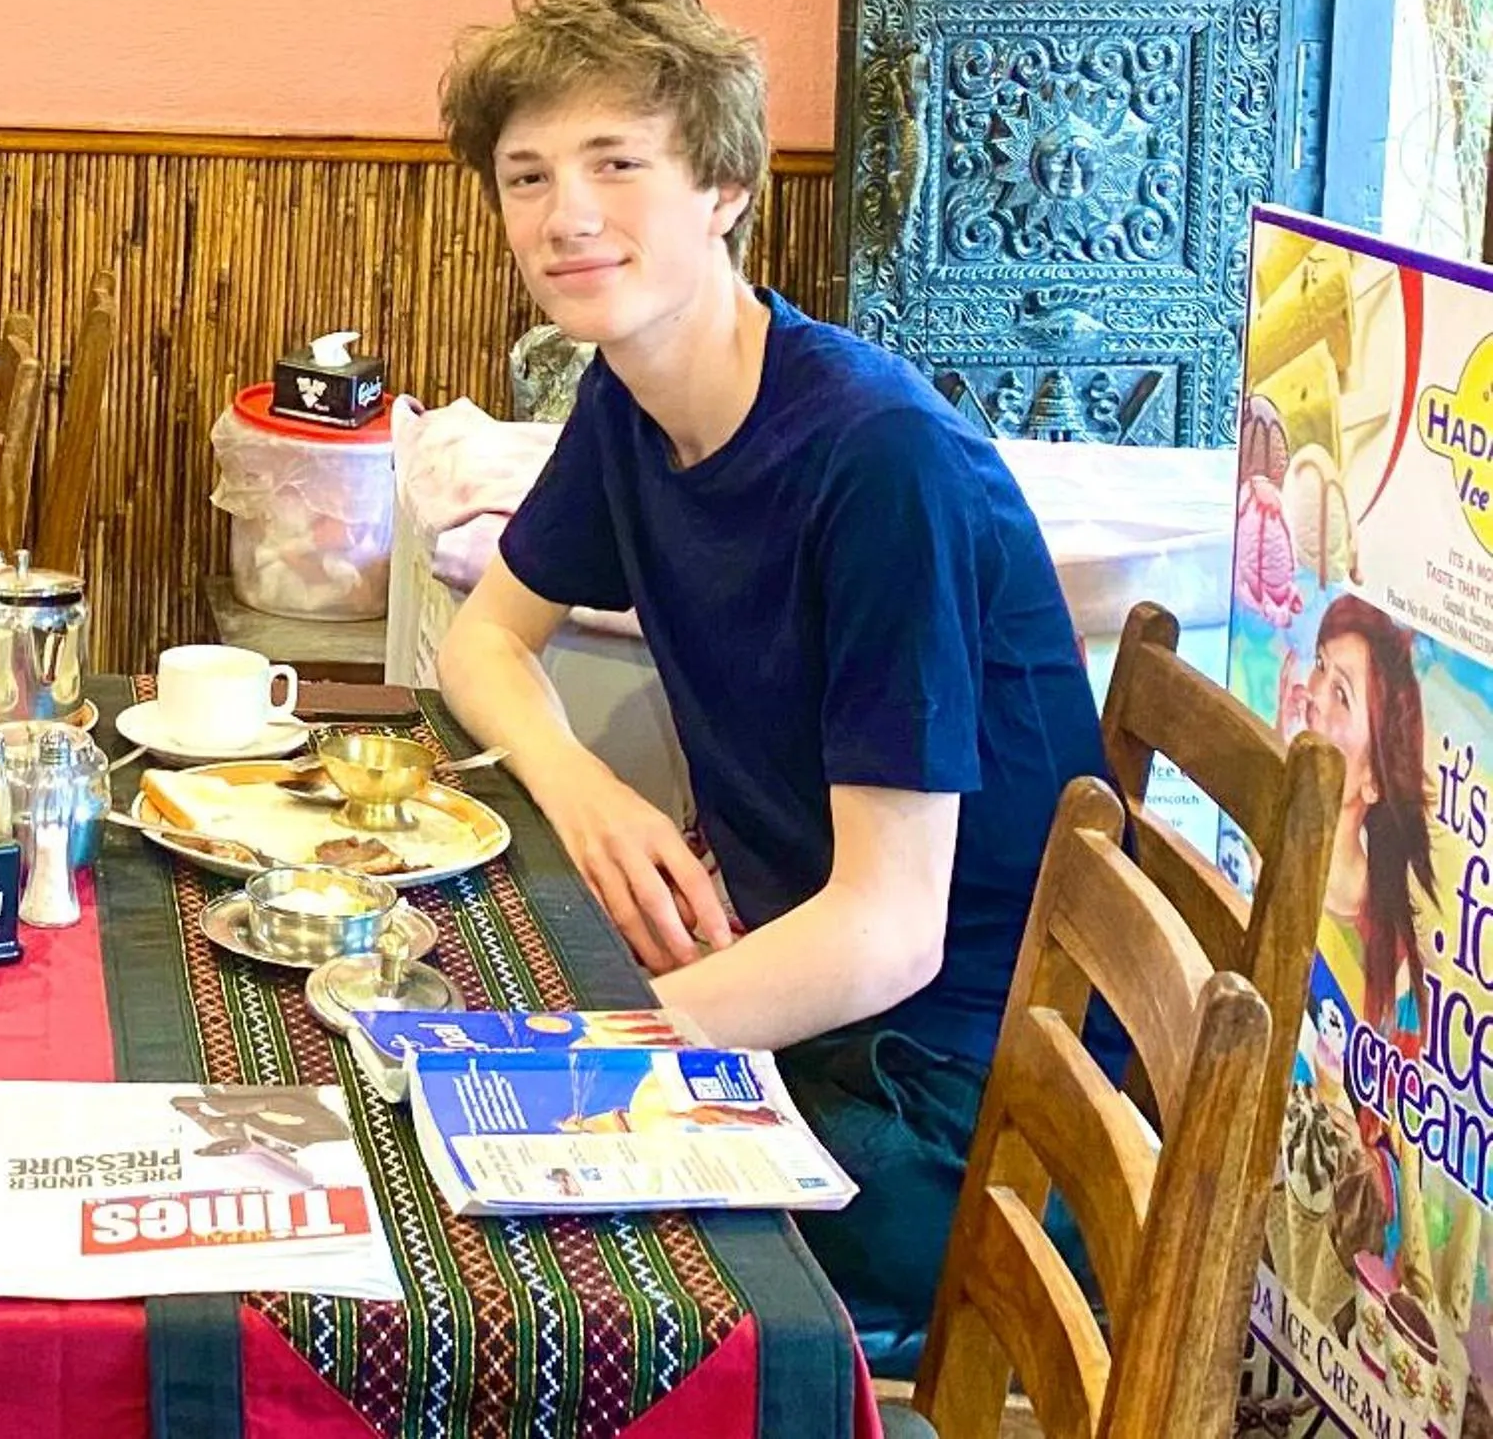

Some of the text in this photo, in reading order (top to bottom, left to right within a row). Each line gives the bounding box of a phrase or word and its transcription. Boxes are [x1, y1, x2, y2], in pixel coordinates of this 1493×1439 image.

[1459, 466, 1490, 512] Ice
[1436, 735, 1489, 851] it's
[7, 1148, 182, 1176] PRESSURE
[8, 1167, 183, 1190] PRESS UNDER
[89, 1189, 348, 1244] Times
[1280, 1290, 1312, 1361] ICE
[1317, 1336, 1392, 1439] CREAM
